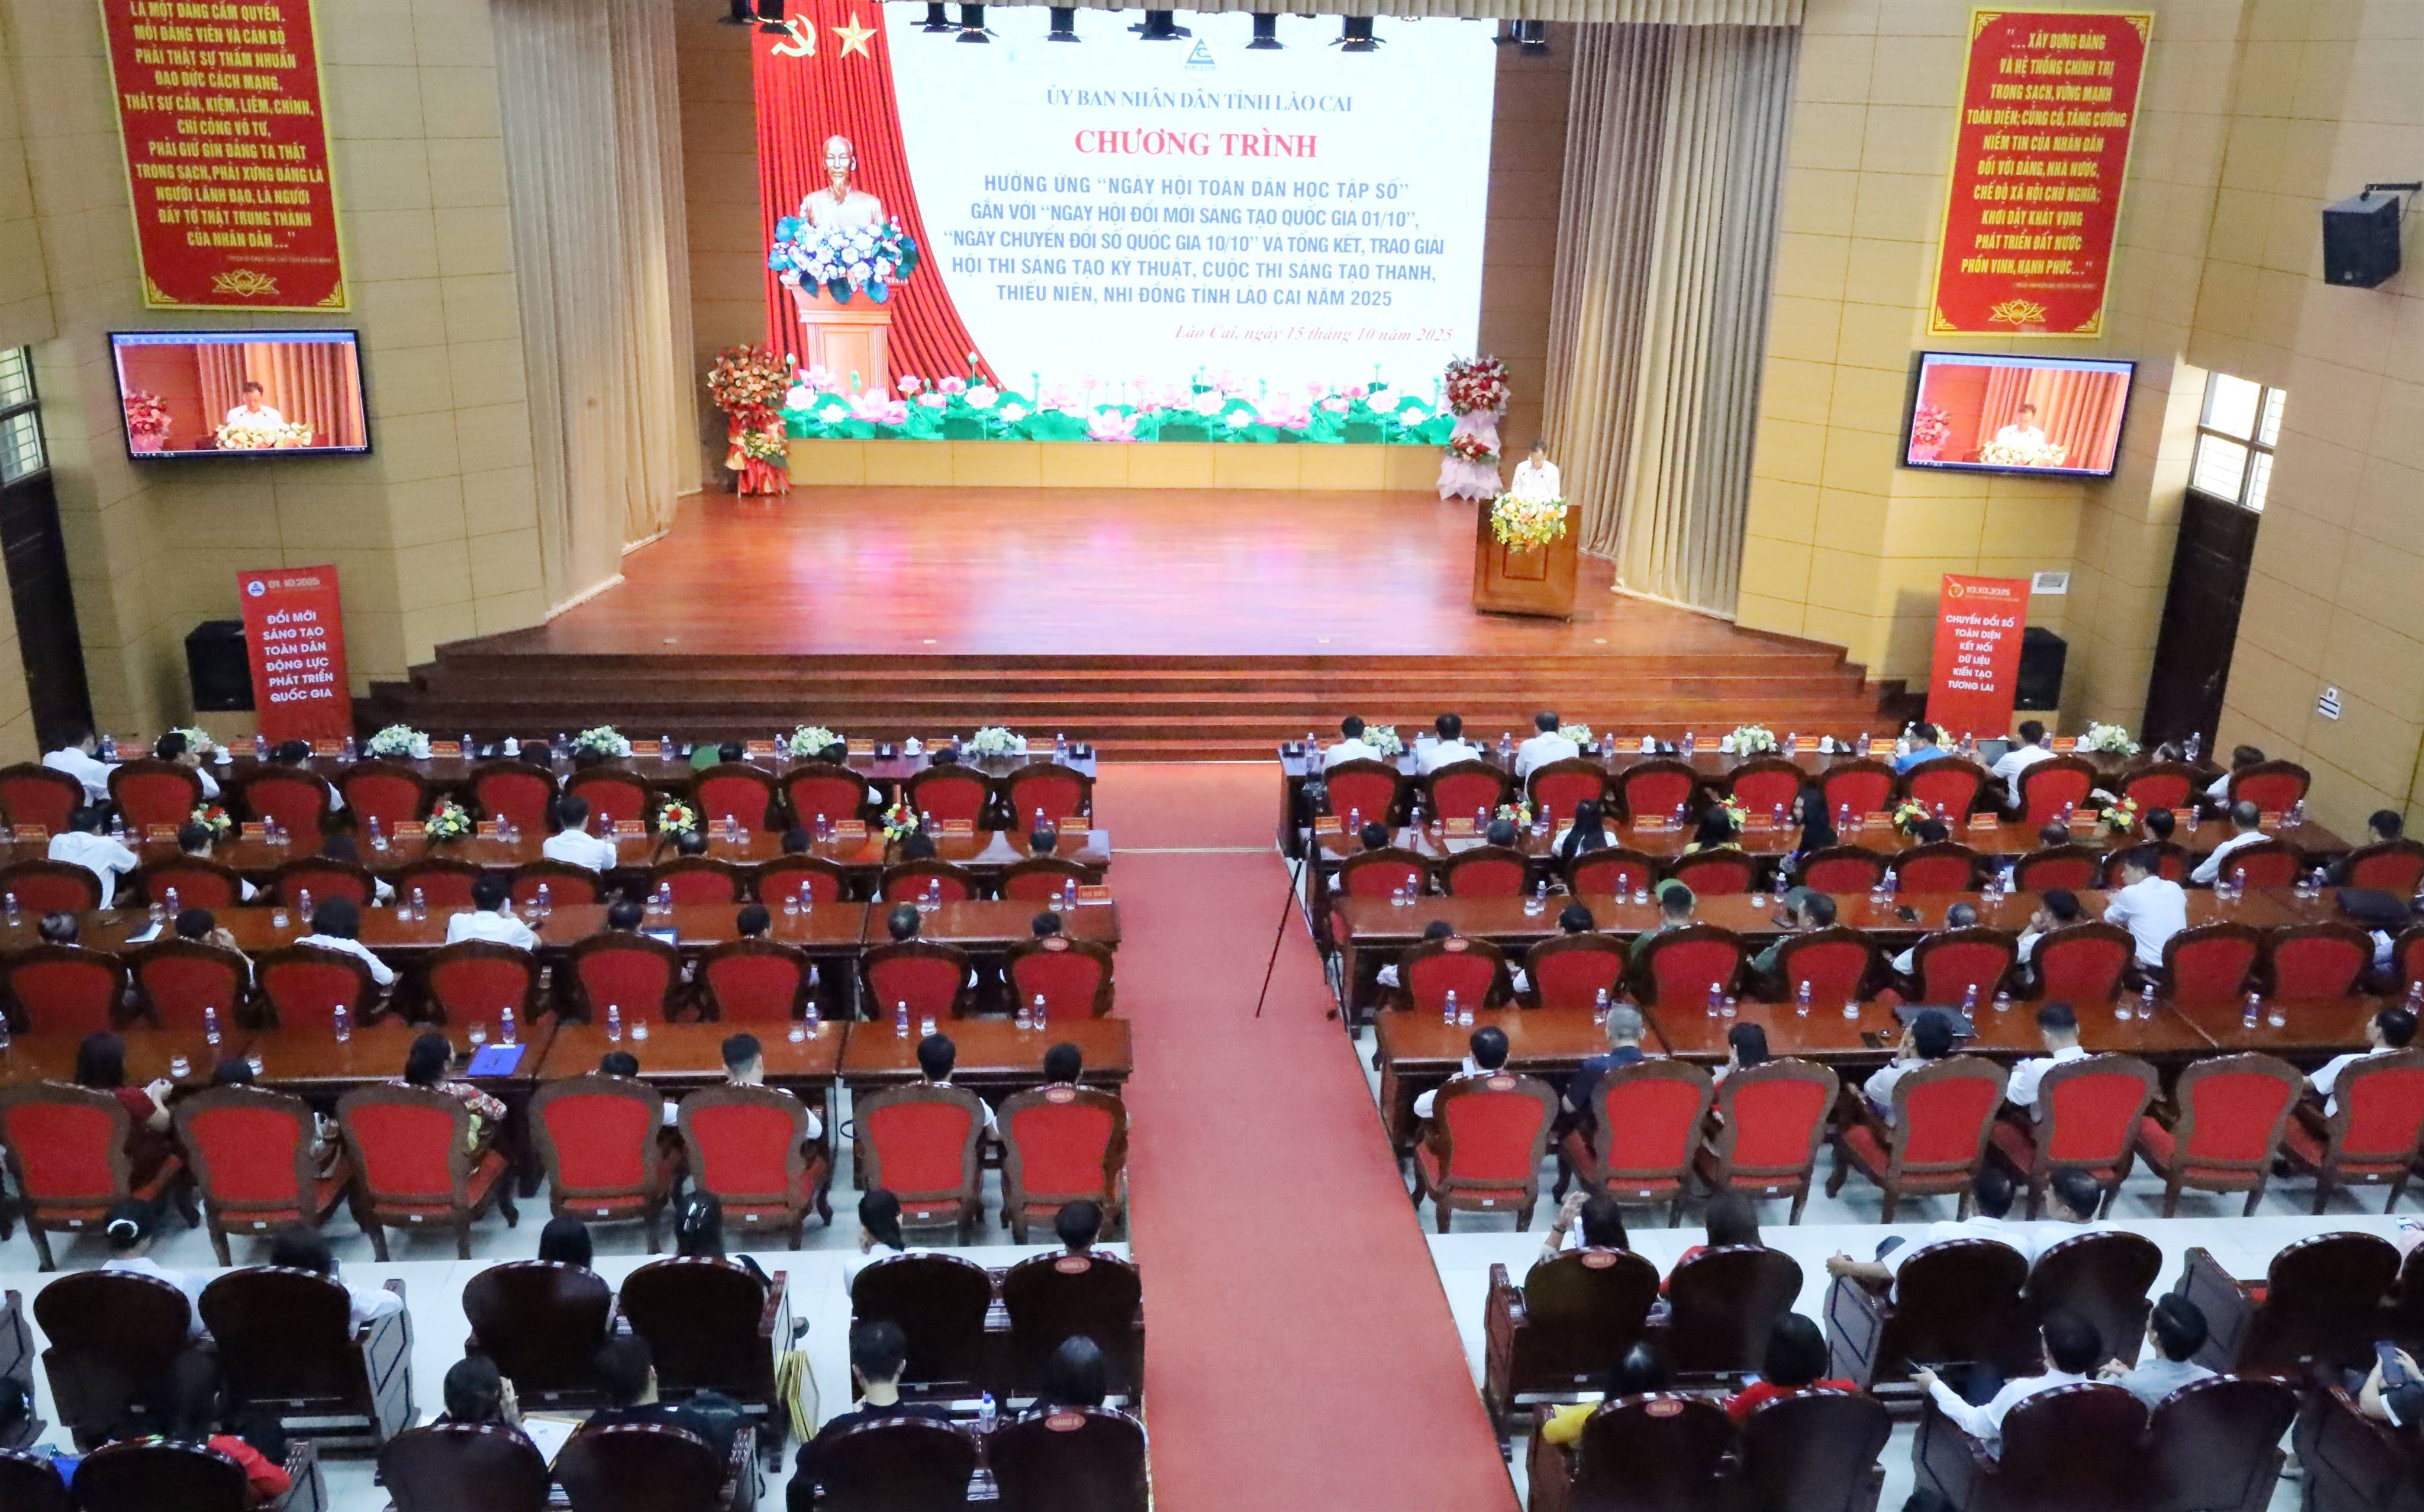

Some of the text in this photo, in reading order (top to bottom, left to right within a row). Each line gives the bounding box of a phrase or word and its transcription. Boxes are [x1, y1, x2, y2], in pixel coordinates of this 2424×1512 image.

[1047, 85, 1352, 112] ỦY BAN NHÂN DÂN TỈNH LÀO CAI
[1075, 127, 1317, 157] CHƯƠNG TRÌNH
[985, 170, 1047, 192] HƯỞNG
[1055, 172, 1090, 193] ỨNG
[1162, 175, 1192, 199] HỘI
[1199, 176, 1244, 196] TOÀN
[1252, 177, 1286, 196] DÂN
[1294, 182, 1329, 202] HỌC
[1337, 178, 1368, 202] TẬP
[971, 197, 1004, 220] GẮN
[1009, 202, 1036, 220] VỚI
[1098, 202, 1125, 225] HỘI
[1130, 199, 1158, 223] ĐỔI
[1164, 205, 1194, 223] MỚI
[1200, 204, 1241, 224] SÁNG
[1247, 209, 1277, 228] TẠO
[1282, 204, 1326, 226] QUỐC
[1332, 211, 1356, 226] GIA
[1001, 225, 1064, 249] CHUYỂN
[1069, 226, 1095, 249] ĐỔI
[1101, 228, 1121, 249] SỐ
[1127, 228, 1171, 251] QUỐC
[1176, 234, 1201, 250] GIA
[1263, 233, 1283, 252] VÀ
[1288, 230, 1328, 253] TỔNG
[1334, 232, 1365, 256] KẾT,
[1369, 237, 1410, 254] TRAO
[1414, 234, 1443, 254] GIẢI
[952, 254, 1436, 283] HỘI THI SÁNG TẠO KỸ THUẬT, CUỘC THI SÁNG TẠO THANH,
[997, 279, 1391, 305] THIẾU NIÊN, NHI ĐỒNG TỈNH LÀO CAI NĂM 2025
[1175, 325, 1453, 343] Lào Cai, ngày 15 tháng 10 năm 2025
[267, 610, 316, 624] ĐỔI MỚI
[1945, 613, 2014, 627] CHUYỂN ĐỔI SỐ
[263, 627, 324, 640] SÁNG TẠO
[1955, 628, 2001, 641] TOÀN DIỆN
[264, 641, 326, 656] TOÀN DÂN
[1960, 640, 1993, 652] KẾT NỐI
[266, 657, 328, 672] ĐỘNG LỰC
[1958, 654, 1990, 666] DỮ LIỆU
[269, 669, 333, 686] PHÁT TRIỂN
[1953, 666, 1992, 679] KIẾN TẠO
[1948, 681, 1994, 691] TƯƠNG LAI
[270, 688, 333, 702] QUỐC GIA
